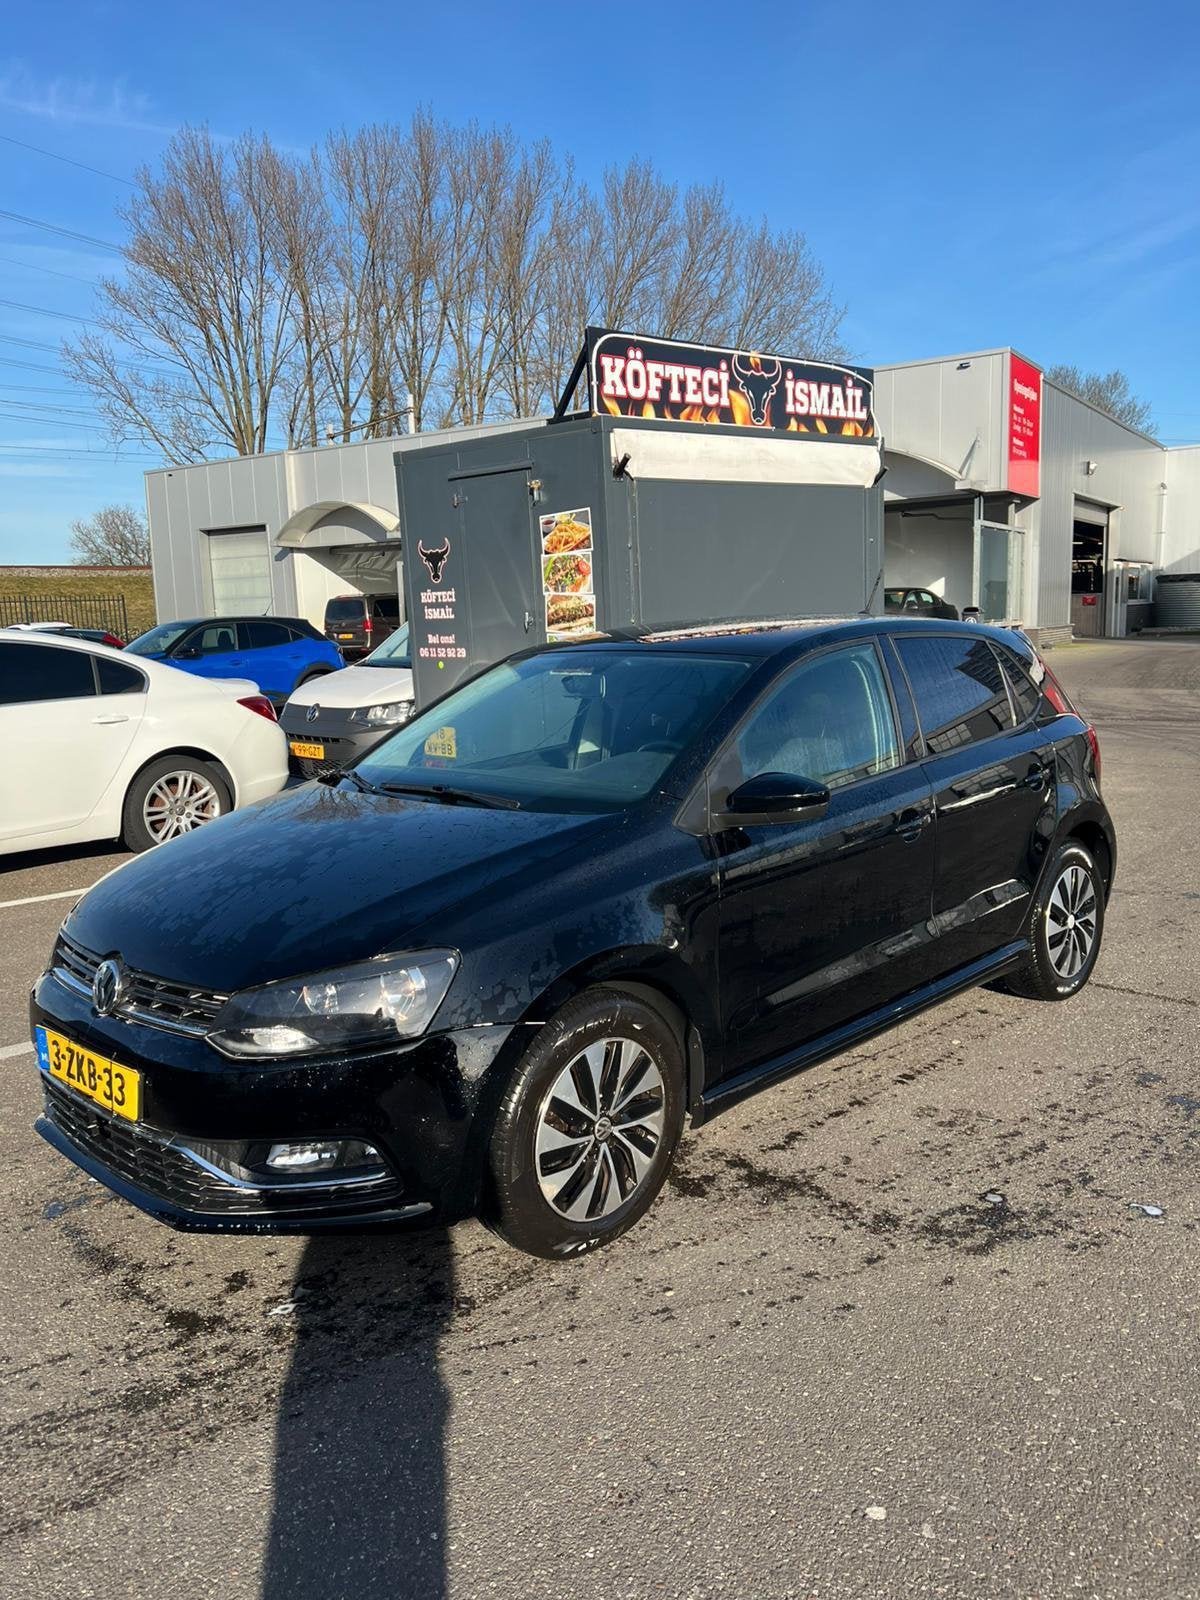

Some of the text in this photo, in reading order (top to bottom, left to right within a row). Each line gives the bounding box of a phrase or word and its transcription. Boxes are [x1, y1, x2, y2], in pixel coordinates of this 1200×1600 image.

[600, 348, 868, 420] KÖFTECİ İSMAİL
[419, 647, 429, 657] 06
[429, 647, 437, 657] 11
[437, 647, 446, 657] 52
[52, 1040, 126, 1106] 3-ZKB-33
